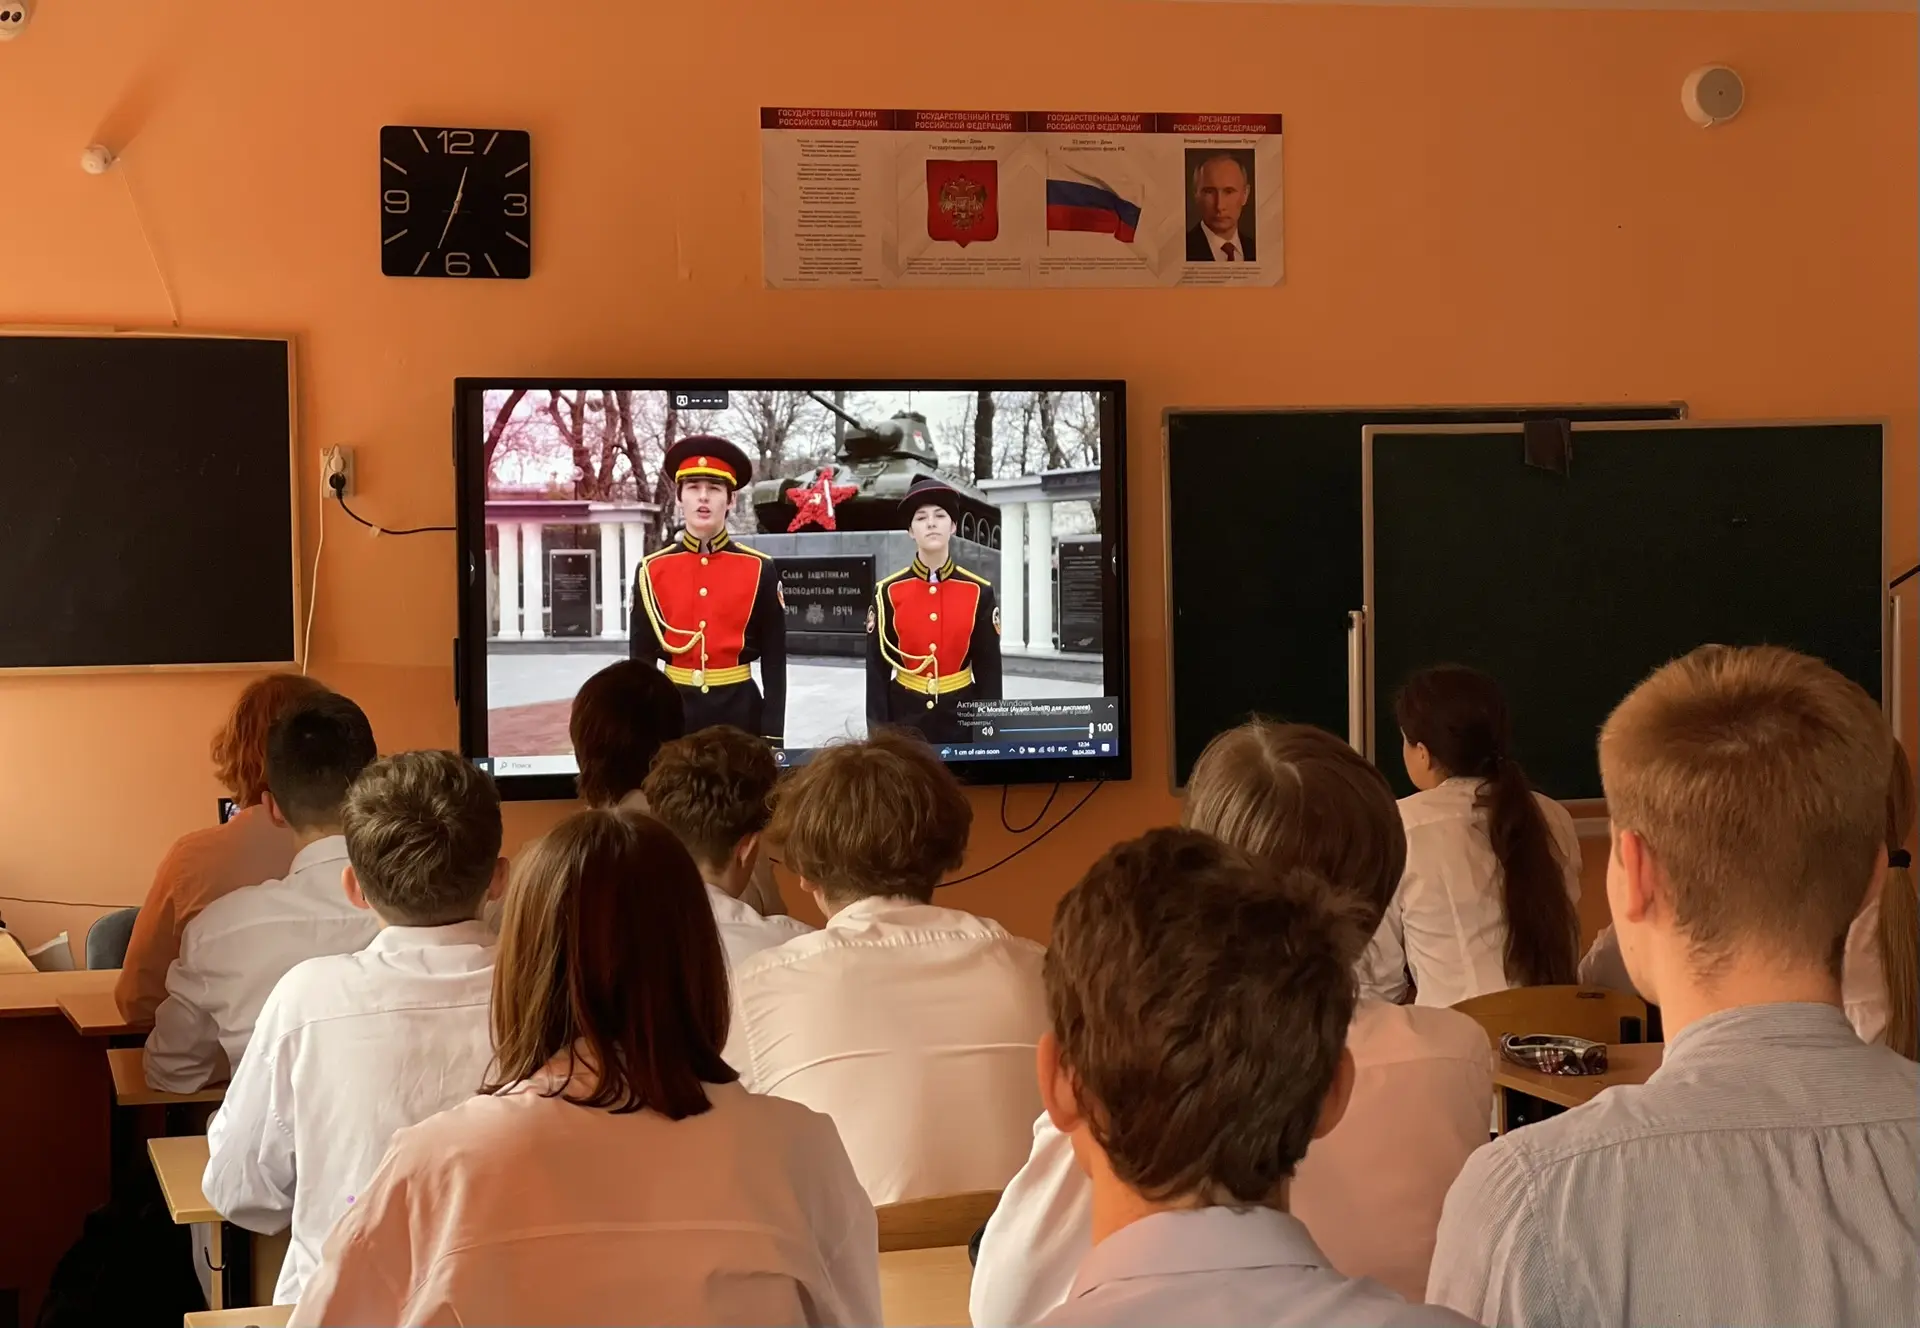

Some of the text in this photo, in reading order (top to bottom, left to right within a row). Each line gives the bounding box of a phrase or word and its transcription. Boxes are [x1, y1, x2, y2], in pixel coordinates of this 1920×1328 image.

[778, 109, 877, 118] ГОСУДАРСТВЕННЫЙ ГИМН
[916, 112, 990, 120] ГОСУДАРСТВЕННЫЙ
[1047, 113, 1141, 122] ГОСУДАРСТВЕННЫЙ ФЛАГ
[778, 118, 878, 127] РОССИЙСКОЙ ФЕДЕРАЦИИ
[1198, 115, 1241, 123] ПРЕЗИДЕНТ
[915, 121, 1012, 130] РОССИЙСКОЙ ФЕДЕРАЦИИ
[1046, 122, 1141, 131] РОССИЙСКОЙ ФЕДЕРАЦИИ
[1173, 124, 1266, 132] РОССИЙСКОЙ ФЕДЕРАЦИИ
[437, 130, 474, 154] 12
[384, 189, 410, 213] 9
[503, 193, 528, 216] 3
[445, 252, 471, 276] 6
[785, 605, 853, 616] 941 1944
[1097, 722, 1113, 732] 100
[968, 748, 975, 756] of
